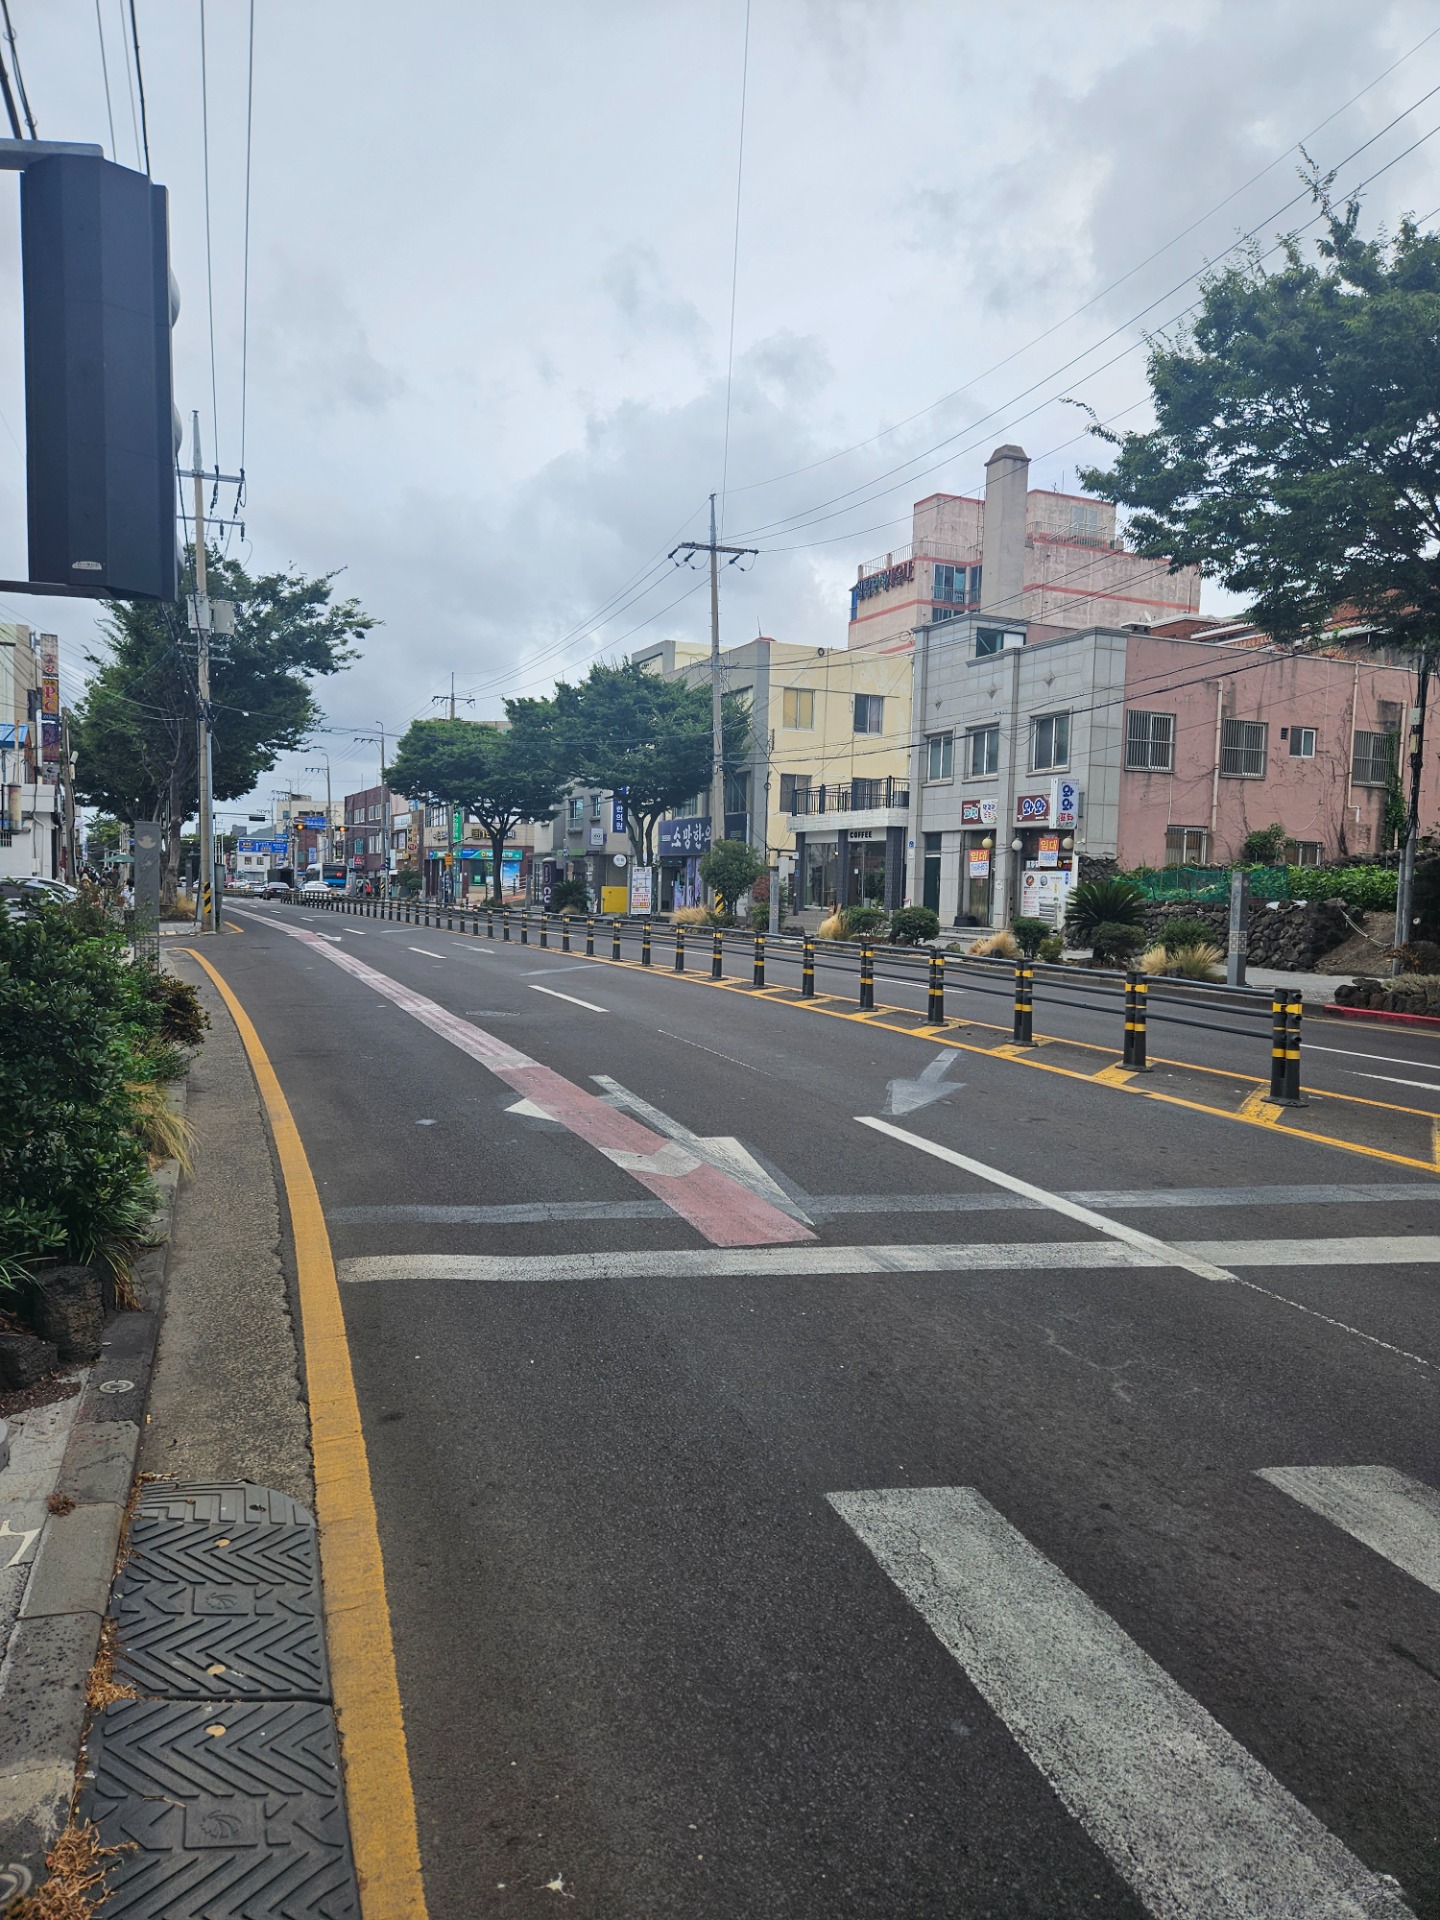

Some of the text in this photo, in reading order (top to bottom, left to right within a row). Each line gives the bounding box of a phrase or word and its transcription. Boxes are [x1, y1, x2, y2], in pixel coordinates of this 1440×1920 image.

[1022, 798, 1046, 815] 와와
[671, 823, 711, 850] 소망한의
[850, 831, 872, 839] COFFEE
[1040, 839, 1057, 851] 임대
[970, 850, 987, 862] 임대
[544, 886, 551, 903] CU
